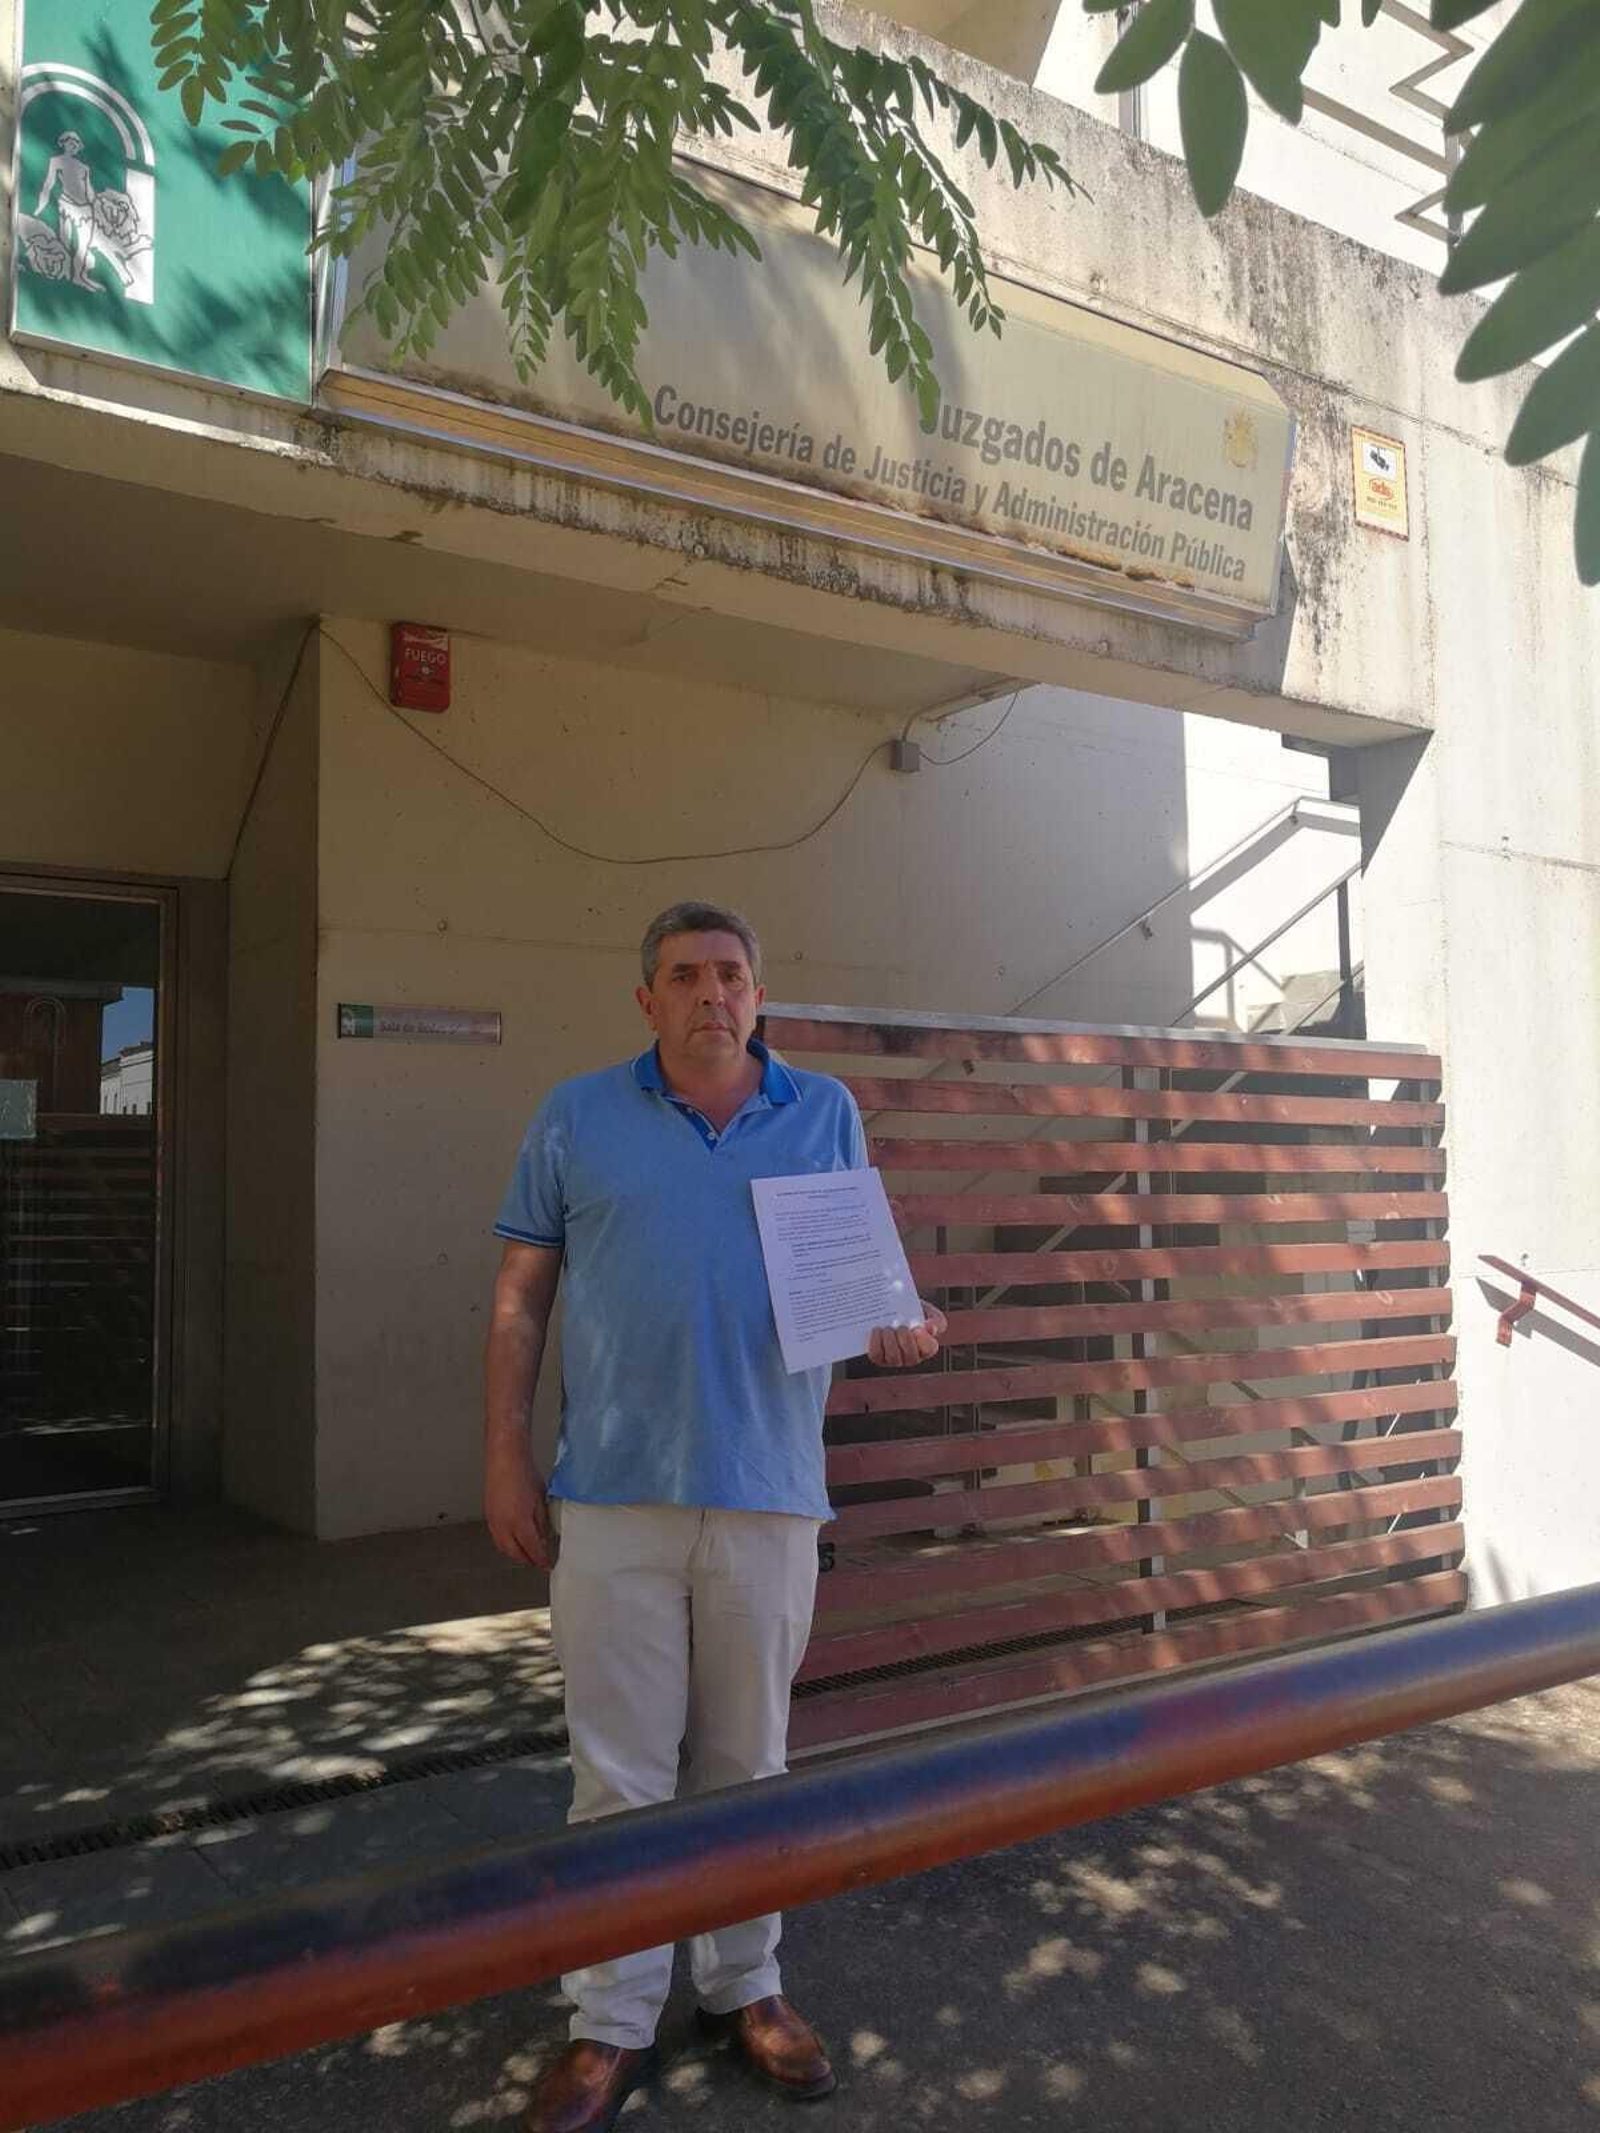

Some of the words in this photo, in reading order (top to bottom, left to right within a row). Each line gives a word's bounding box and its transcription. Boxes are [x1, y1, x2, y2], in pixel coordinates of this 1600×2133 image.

[654, 384, 813, 463] Consejería
[822, 434, 856, 474] de
[864, 445, 965, 504] Justicia
[972, 484, 989, 514] y
[992, 480, 1165, 560] Administración
[1170, 532, 1247, 582] Pública
[1090, 441, 1128, 492] de
[1135, 454, 1253, 532] Aracena
[404, 647, 448, 666] FUEGO
